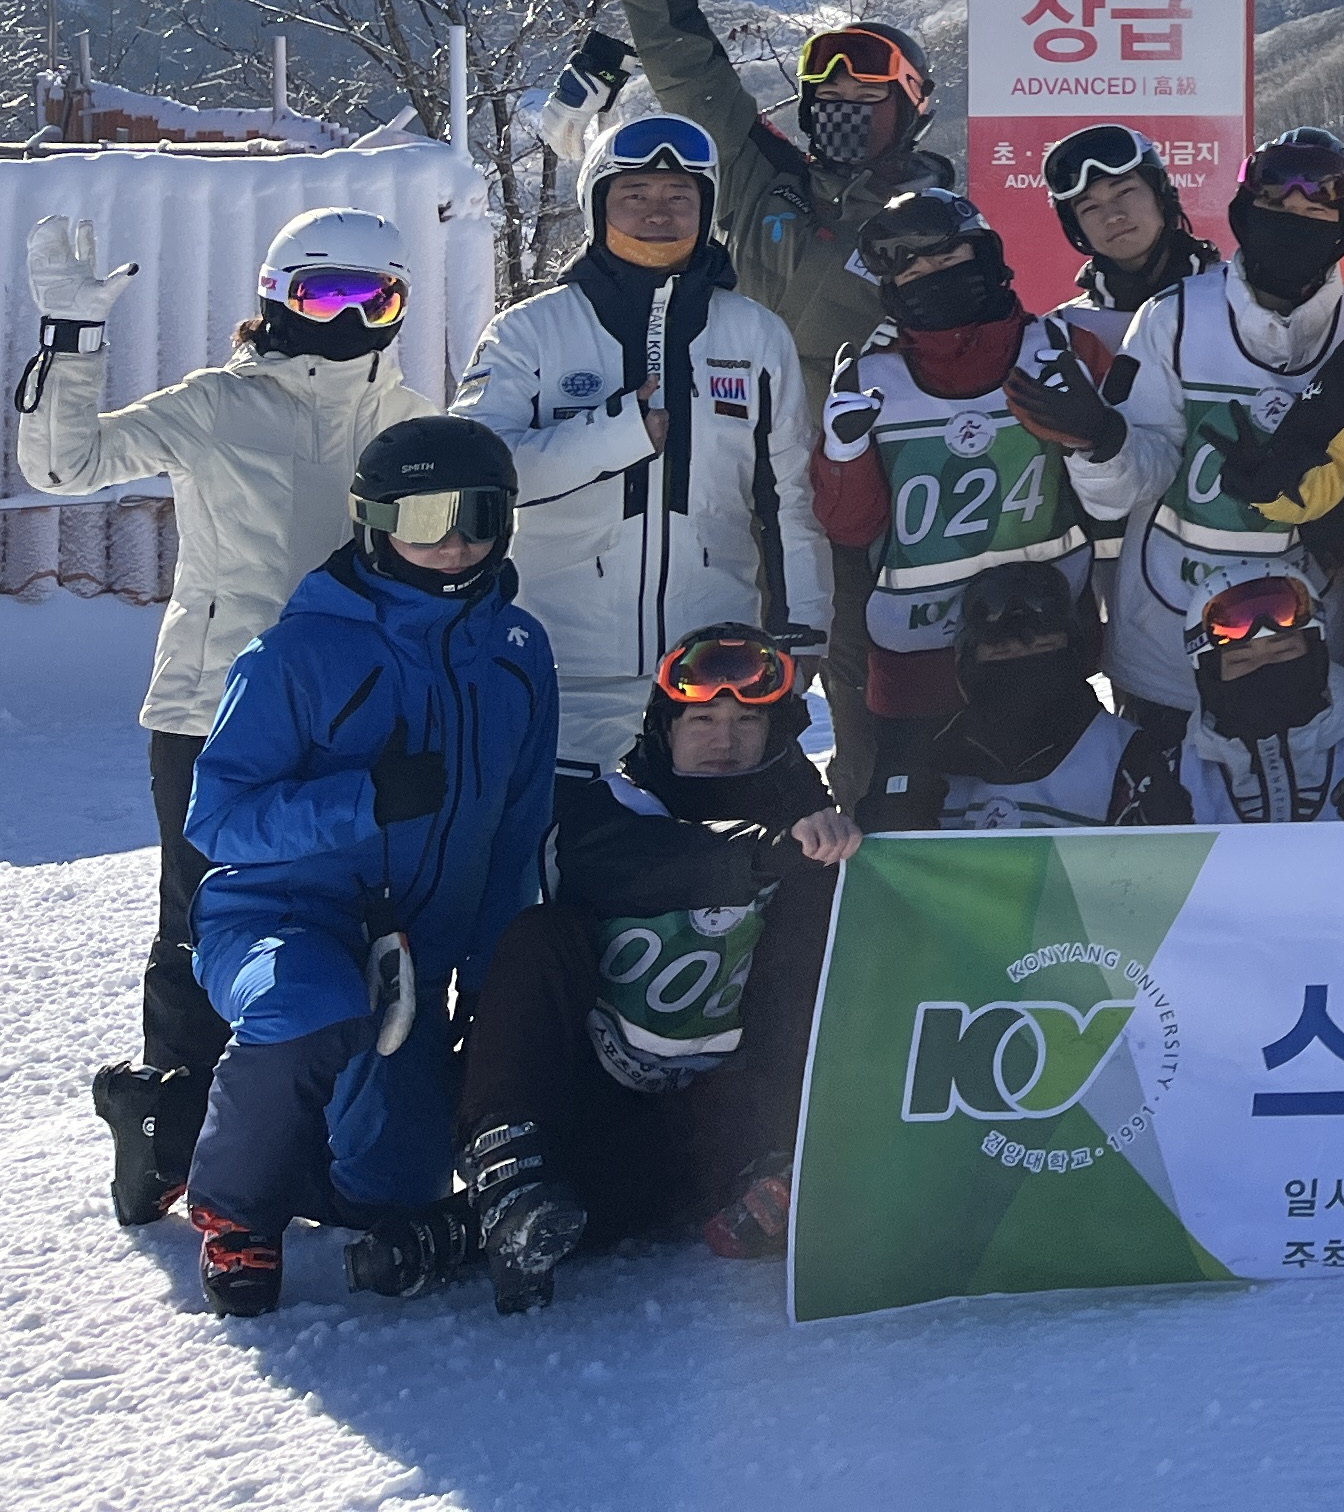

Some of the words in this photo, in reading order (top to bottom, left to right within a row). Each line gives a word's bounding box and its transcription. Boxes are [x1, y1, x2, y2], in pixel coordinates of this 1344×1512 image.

[1010, 77, 1137, 96] ADVANCED
[1153, 76, 1198, 96] 高級
[1155, 141, 1219, 166] 입금지
[1005, 174, 1046, 190] ADVA
[648, 299, 666, 337] TEAM
[401, 462, 435, 474] SMITH
[897, 453, 1049, 548] 024
[1007, 942, 1120, 983] KONYANG
[1125, 960, 1181, 1092] UNIVERSITY
[1107, 1105, 1157, 1151] 1991
[982, 1130, 1093, 1173] 건양대학교
